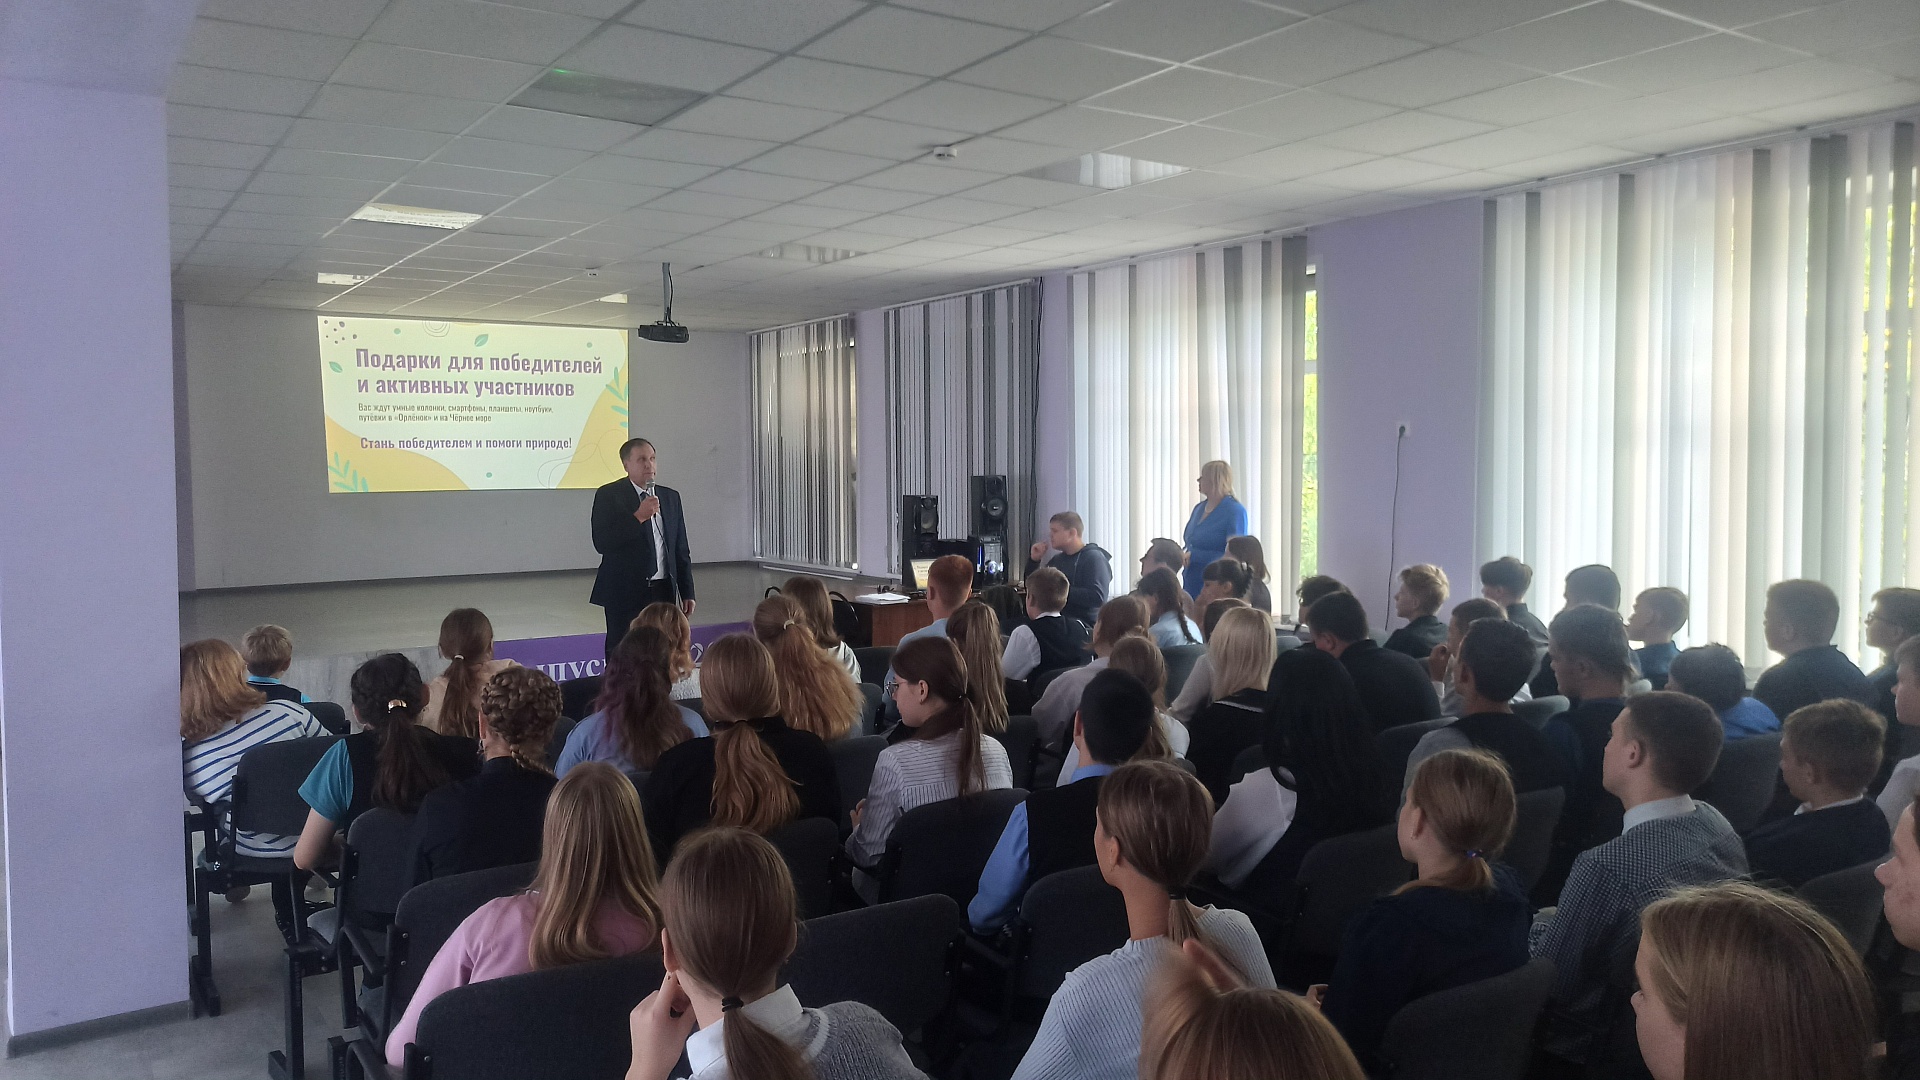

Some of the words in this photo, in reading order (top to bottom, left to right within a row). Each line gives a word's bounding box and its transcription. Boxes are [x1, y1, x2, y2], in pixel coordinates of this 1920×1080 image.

[356, 348, 441, 372] Подарки
[447, 353, 484, 372] для
[490, 353, 602, 375] победителей
[357, 379, 369, 393] и
[376, 379, 468, 395] активных
[474, 381, 575, 397] участников
[358, 403, 371, 411] Вас
[448, 404, 487, 412] смартфоны,
[450, 414, 473, 422] Чёрное
[476, 415, 491, 423] море
[361, 437, 395, 449] Стань
[398, 438, 472, 450] победителем
[475, 440, 482, 448] и
[485, 440, 521, 449] помоги
[525, 438, 572, 450] природе!
[536, 658, 607, 682] пус
